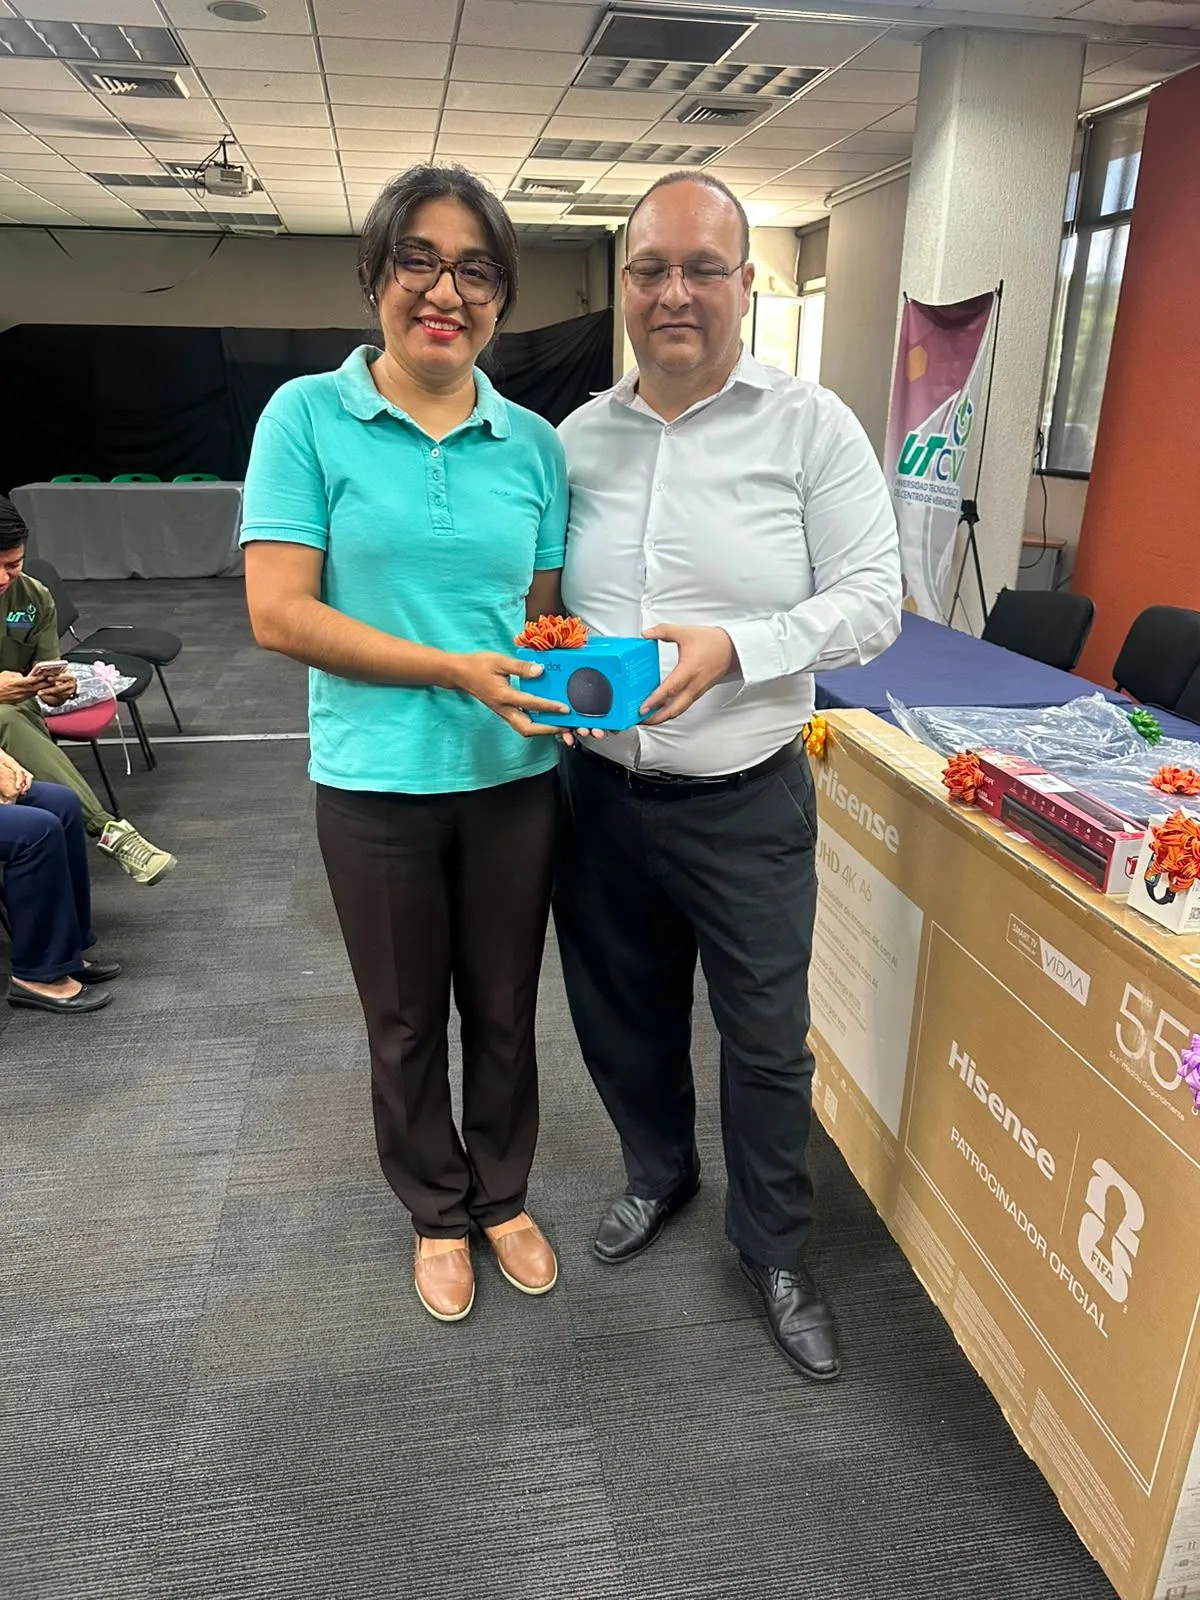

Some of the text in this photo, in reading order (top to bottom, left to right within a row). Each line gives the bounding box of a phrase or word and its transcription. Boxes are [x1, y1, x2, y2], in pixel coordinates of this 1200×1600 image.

[817, 766, 900, 855] Hisense
[841, 863, 857, 894] 4K
[1115, 981, 1190, 1091] 55
[948, 1039, 1056, 1182] Hisense
[950, 1126, 1048, 1258] PATROCINADOR
[1049, 1251, 1109, 1339] OFICIAL
[1090, 1250, 1114, 1285] FIFA
